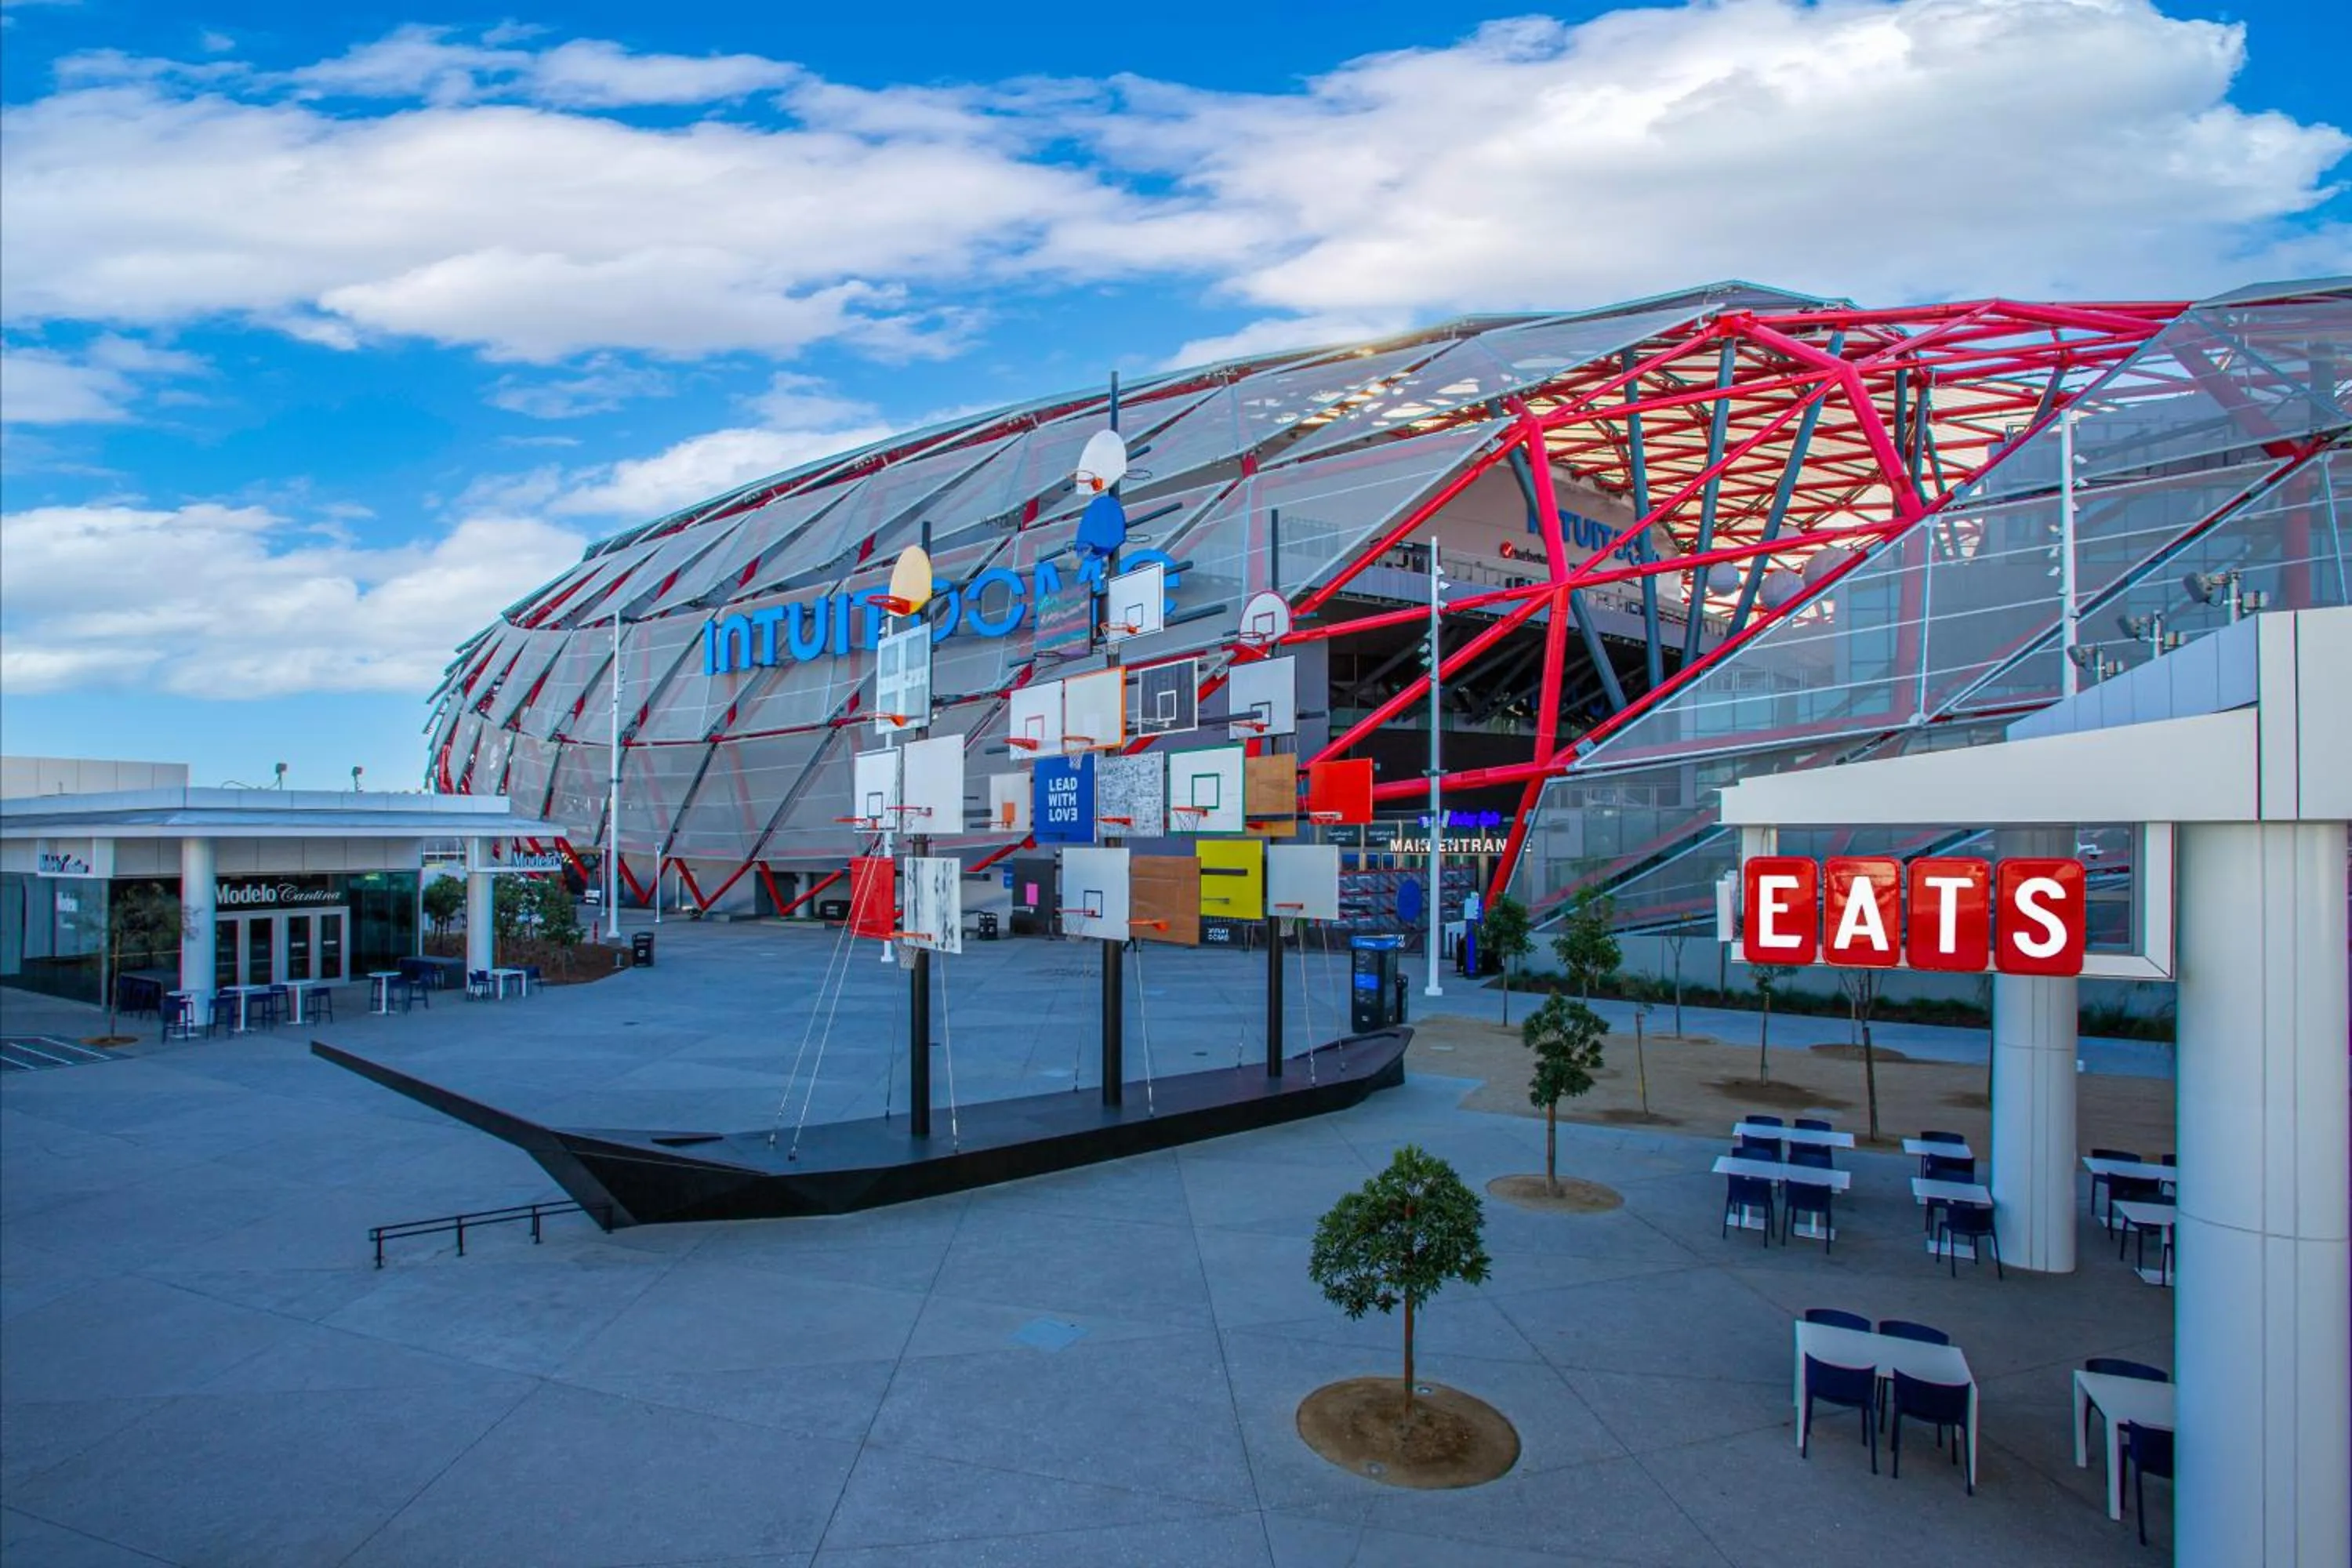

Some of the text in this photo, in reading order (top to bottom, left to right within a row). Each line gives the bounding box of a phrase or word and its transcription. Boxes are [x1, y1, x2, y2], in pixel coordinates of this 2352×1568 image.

[1527, 510, 1613, 553] ITUIT
[1049, 777, 1078, 792] LEAD
[1048, 793, 1076, 807] WITH
[216, 883, 341, 903] Modelo Cantina
[1759, 875, 2067, 958] EATS
